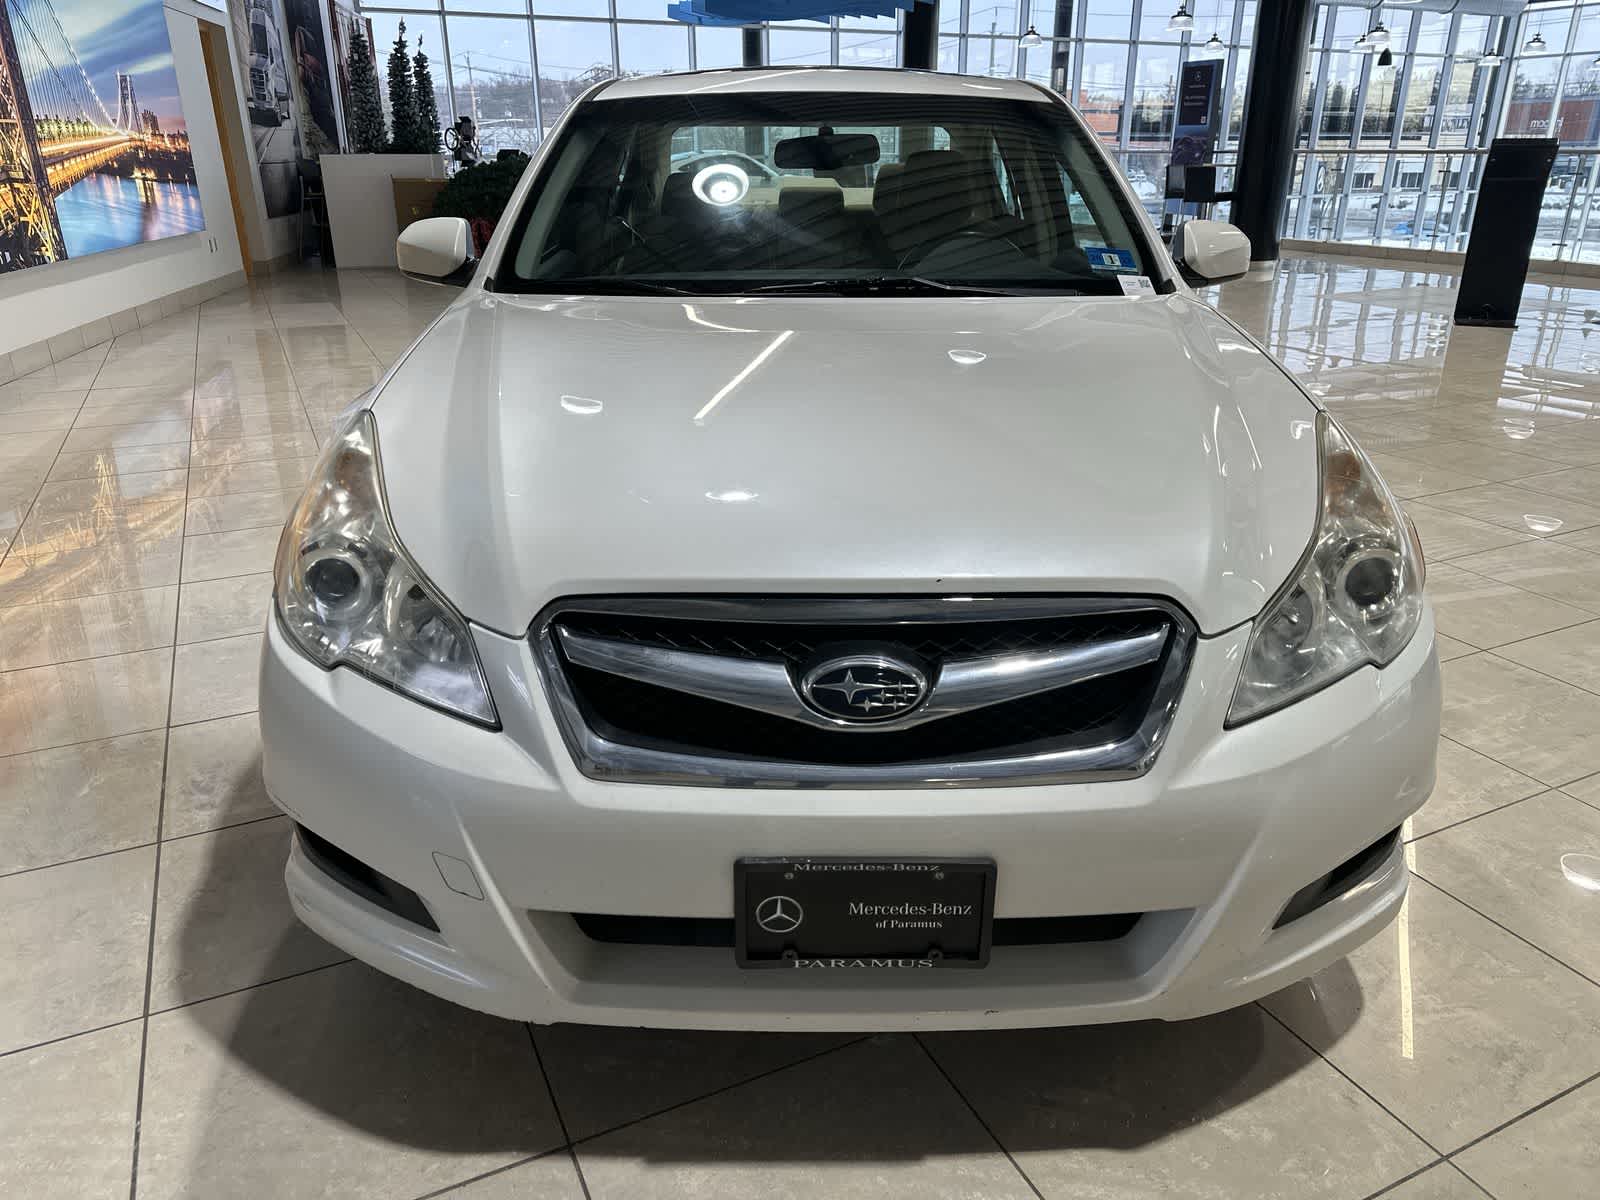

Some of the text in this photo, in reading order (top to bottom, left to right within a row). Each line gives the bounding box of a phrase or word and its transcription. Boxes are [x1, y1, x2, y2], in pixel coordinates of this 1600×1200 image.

[794, 863, 941, 872] Mercedes-Benz
[849, 902, 973, 916] Mercedes-Benz
[875, 919, 943, 929] of Paramus
[794, 959, 934, 968] PARAMUS
